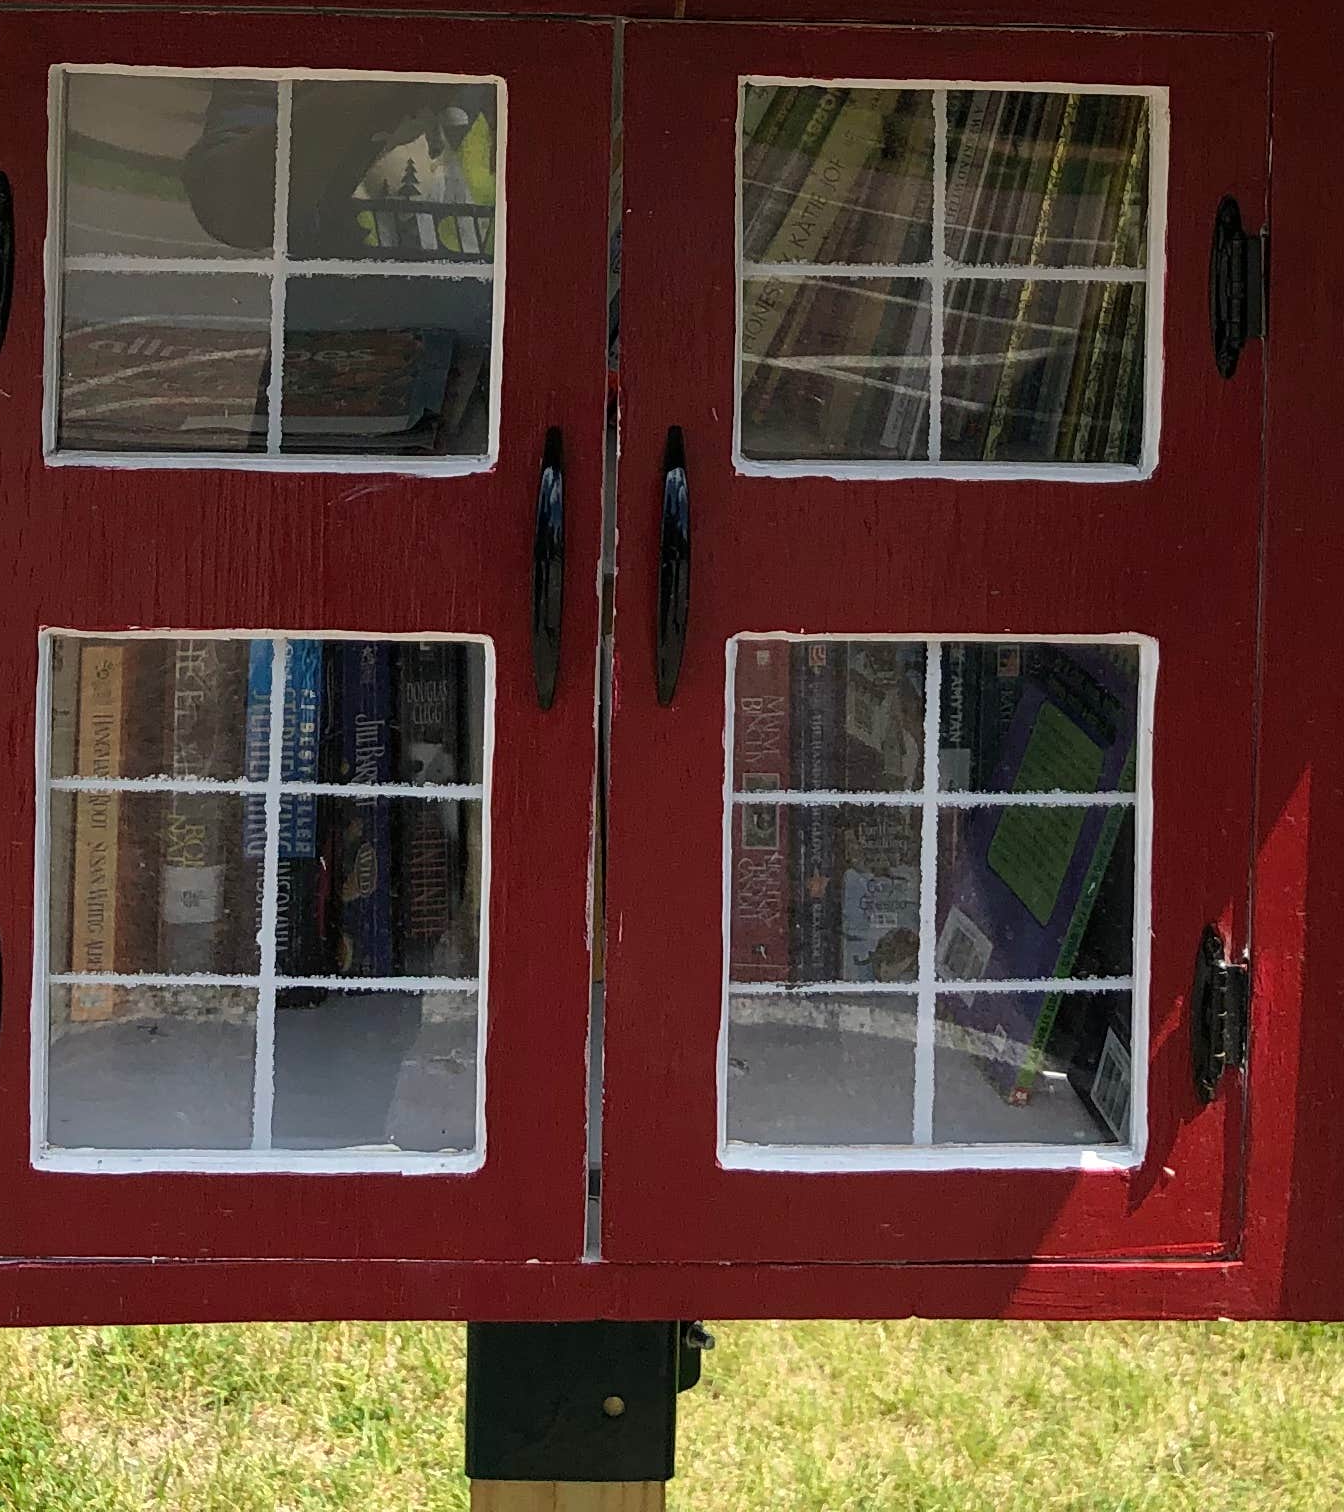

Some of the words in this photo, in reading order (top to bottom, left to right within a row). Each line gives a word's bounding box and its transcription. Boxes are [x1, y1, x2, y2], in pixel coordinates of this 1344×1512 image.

[355, 713, 386, 746] JILL
[296, 721, 317, 854] BESTELLER
[354, 745, 386, 808] BARTT
